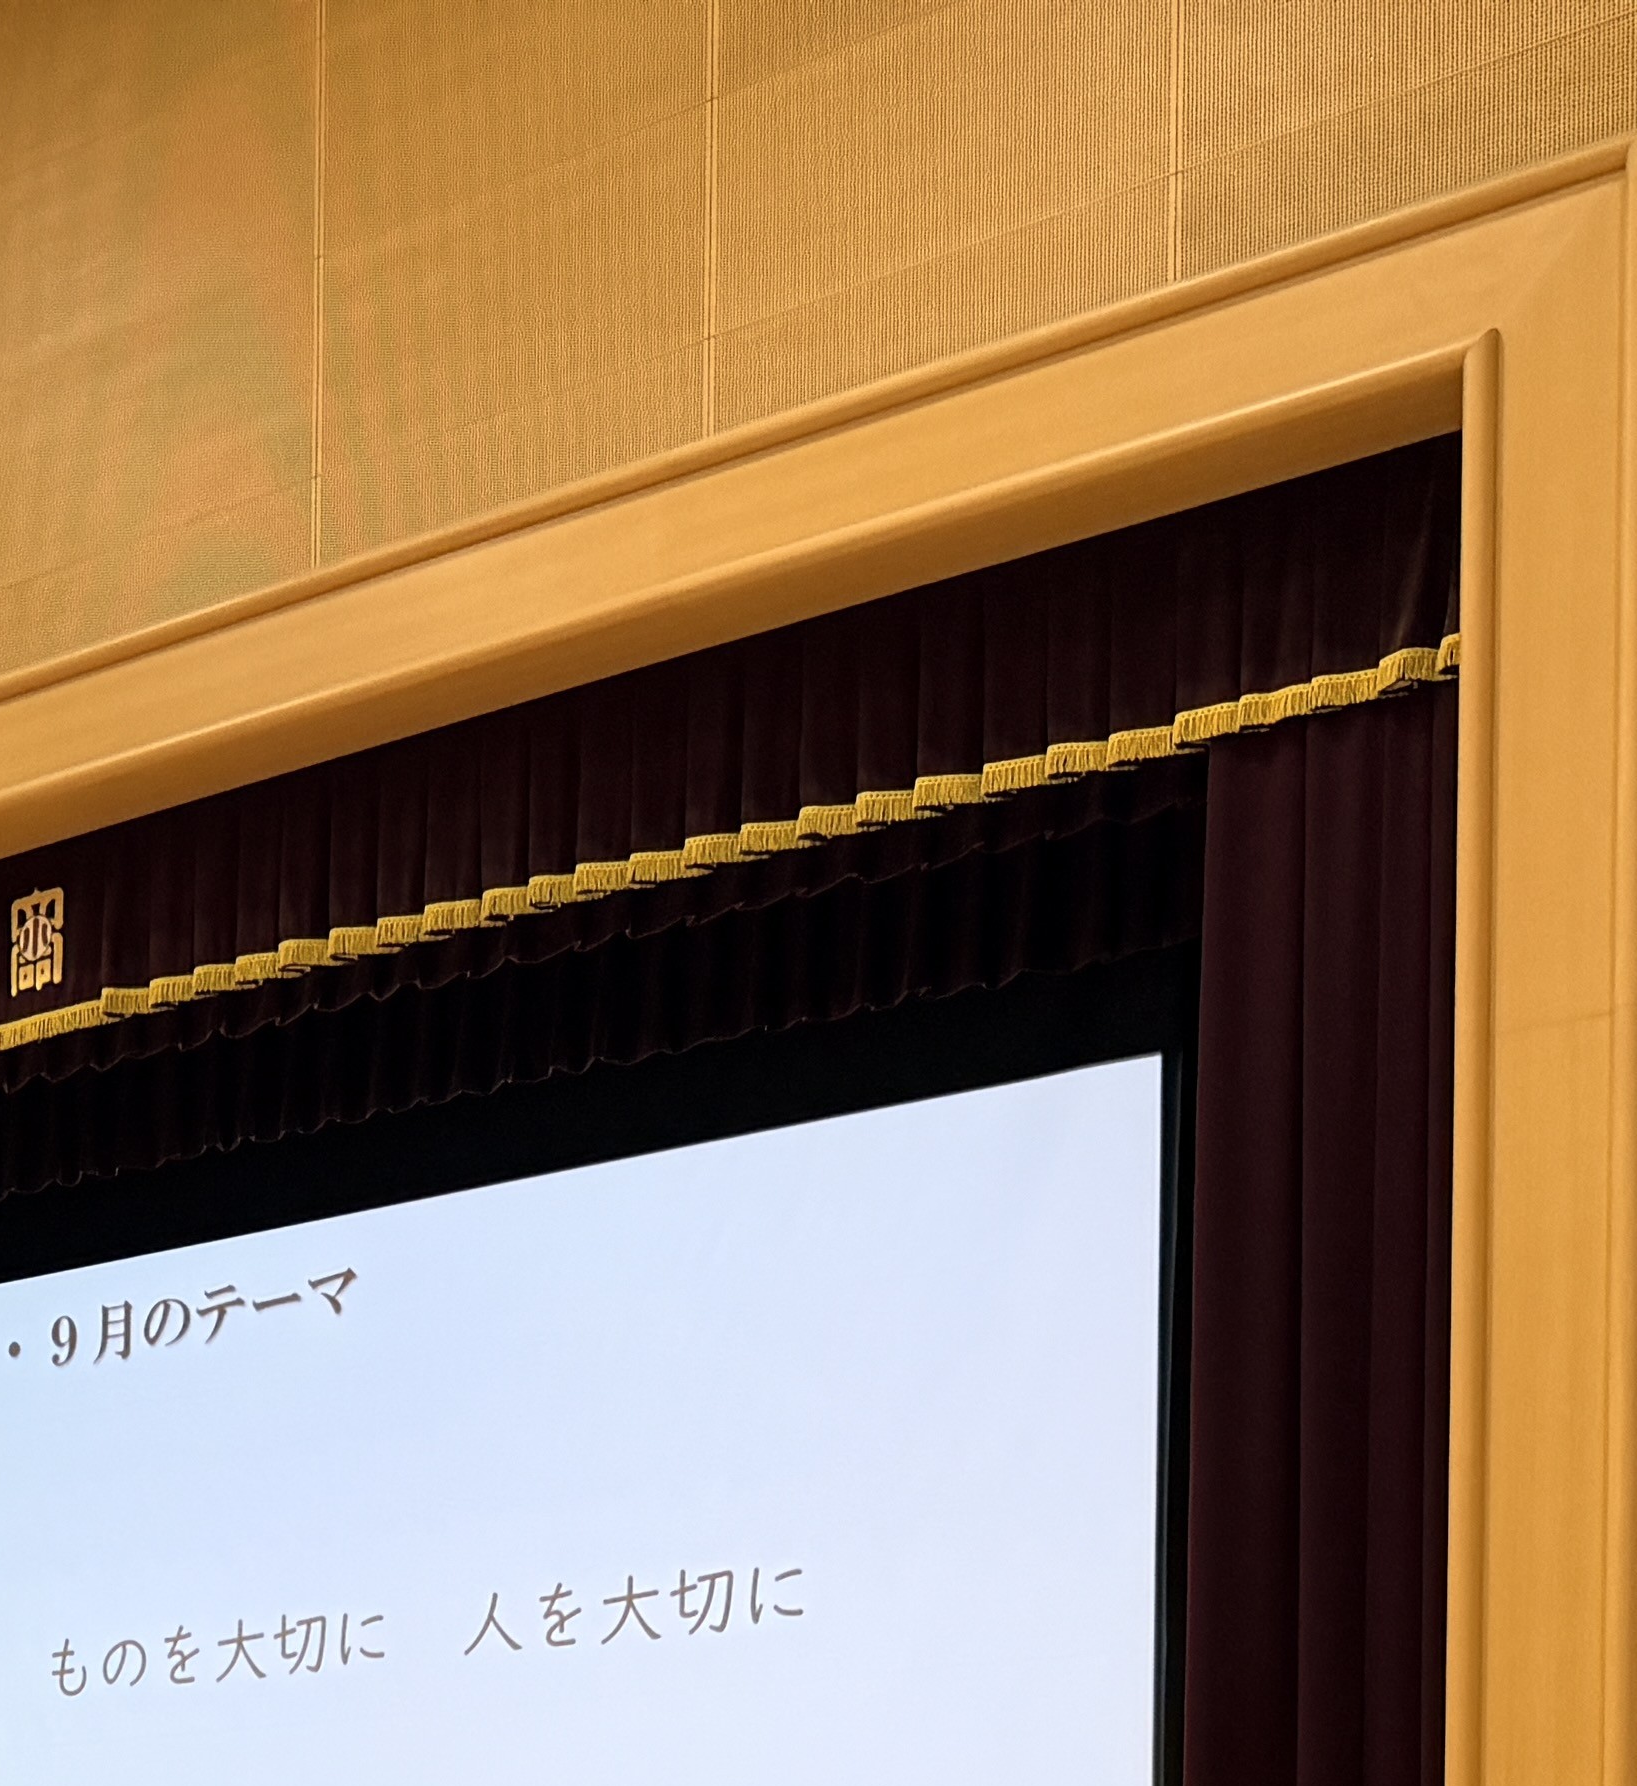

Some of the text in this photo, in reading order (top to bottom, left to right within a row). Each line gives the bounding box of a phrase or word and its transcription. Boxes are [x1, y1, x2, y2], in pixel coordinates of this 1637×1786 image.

[51, 1566, 806, 1698] ものを大切に 人を大切に
